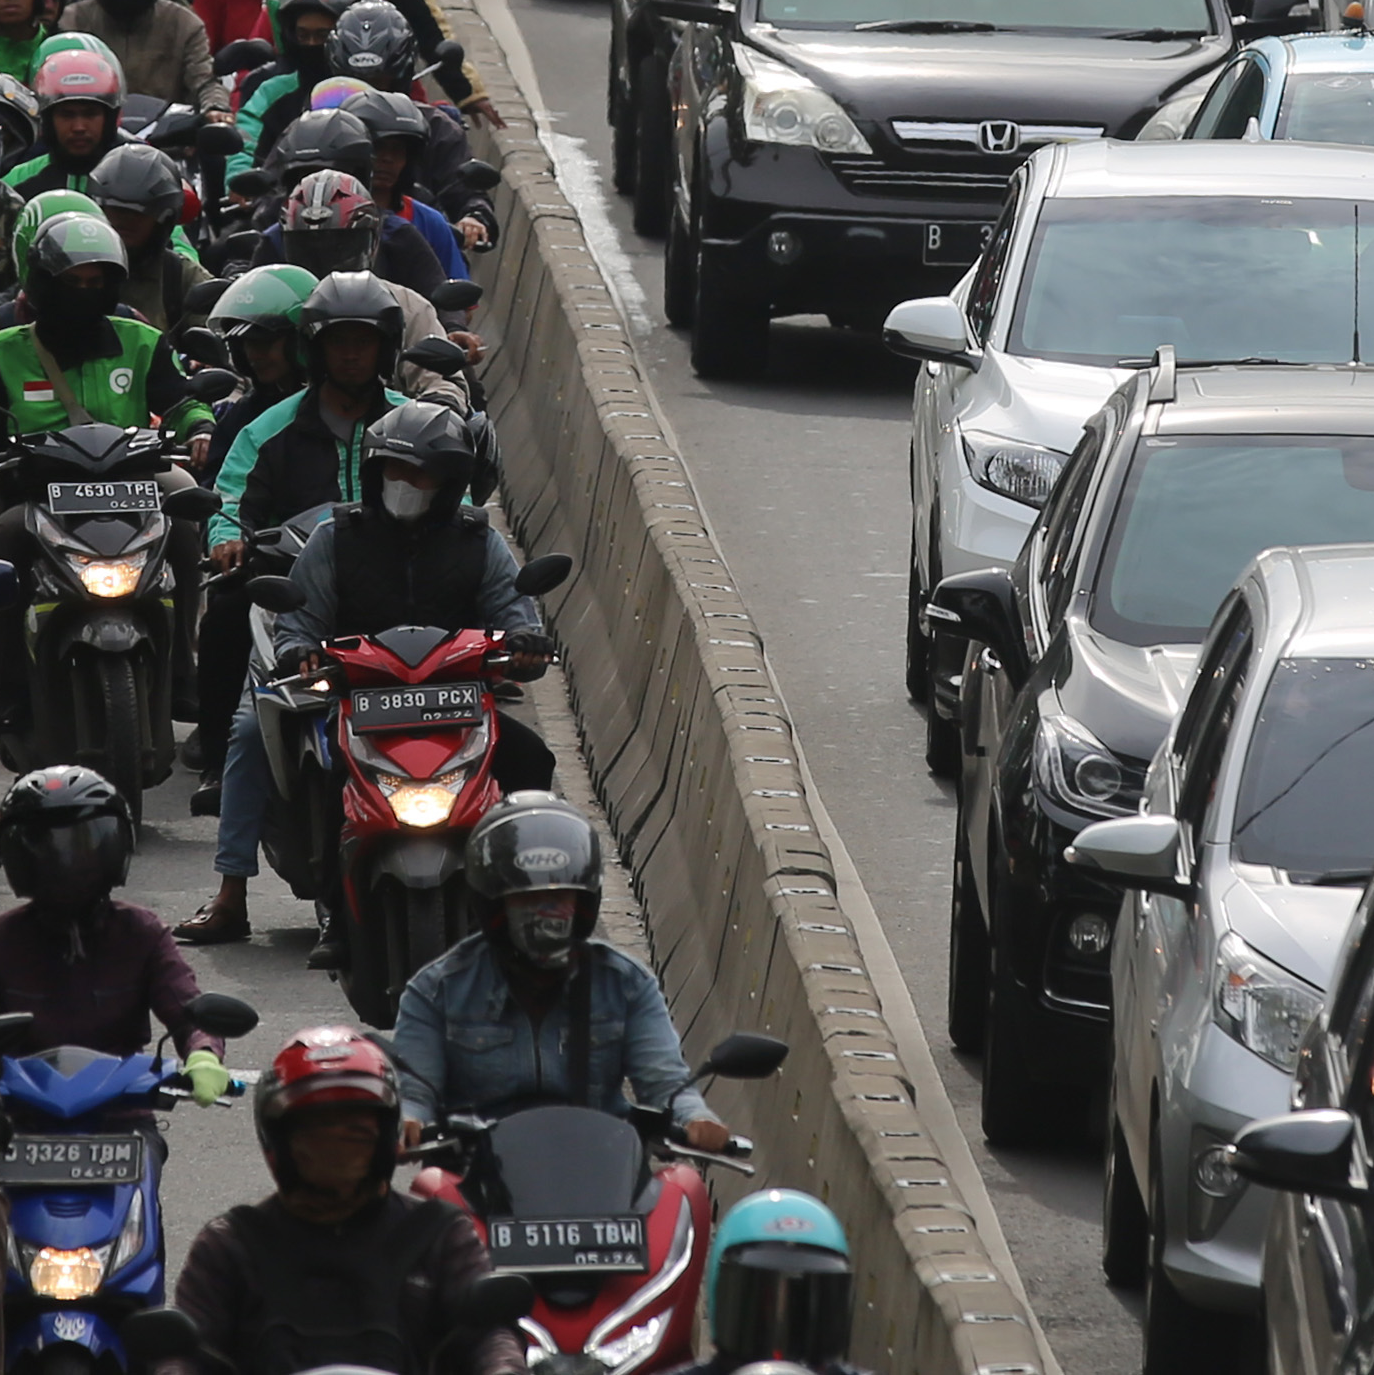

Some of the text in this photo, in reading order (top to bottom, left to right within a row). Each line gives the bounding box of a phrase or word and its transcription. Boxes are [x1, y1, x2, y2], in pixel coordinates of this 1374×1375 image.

[928, 225, 941, 250] B
[51, 482, 155, 498] B 4630 TPE
[359, 696, 370, 712] B
[380, 692, 426, 710] 3830
[25, 1143, 81, 1163] 3326
[89, 1143, 131, 1163] TBM
[497, 1222, 637, 1248] B 5116 TBW
